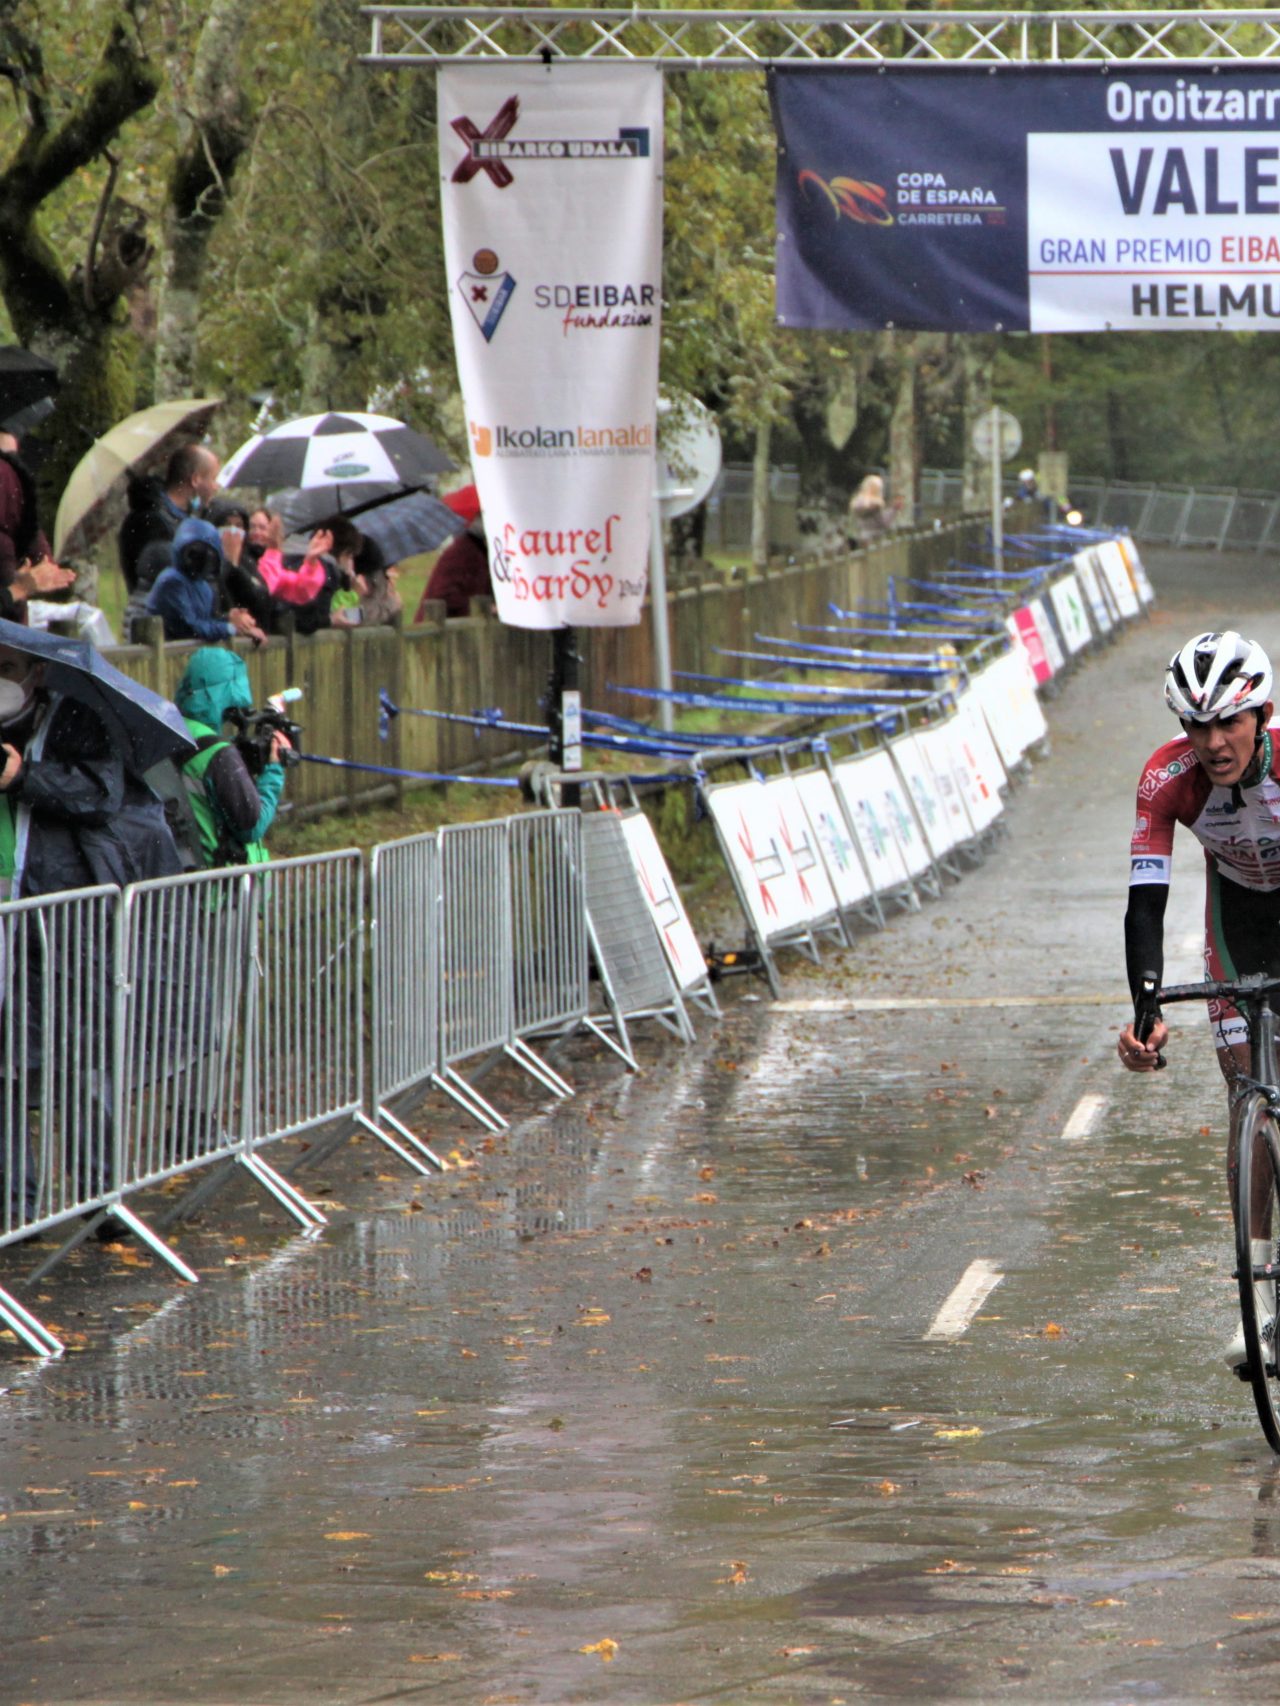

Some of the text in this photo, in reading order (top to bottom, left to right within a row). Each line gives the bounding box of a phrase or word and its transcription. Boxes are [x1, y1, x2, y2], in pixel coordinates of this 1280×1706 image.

[478, 142, 632, 157] EIBARKO UDALA
[897, 173, 946, 187] COPA
[897, 187, 997, 204] DE ESPAÑA
[898, 213, 982, 225] CARRETERA
[1040, 238, 1106, 264] GRAN
[1116, 238, 1211, 263] PREMIO
